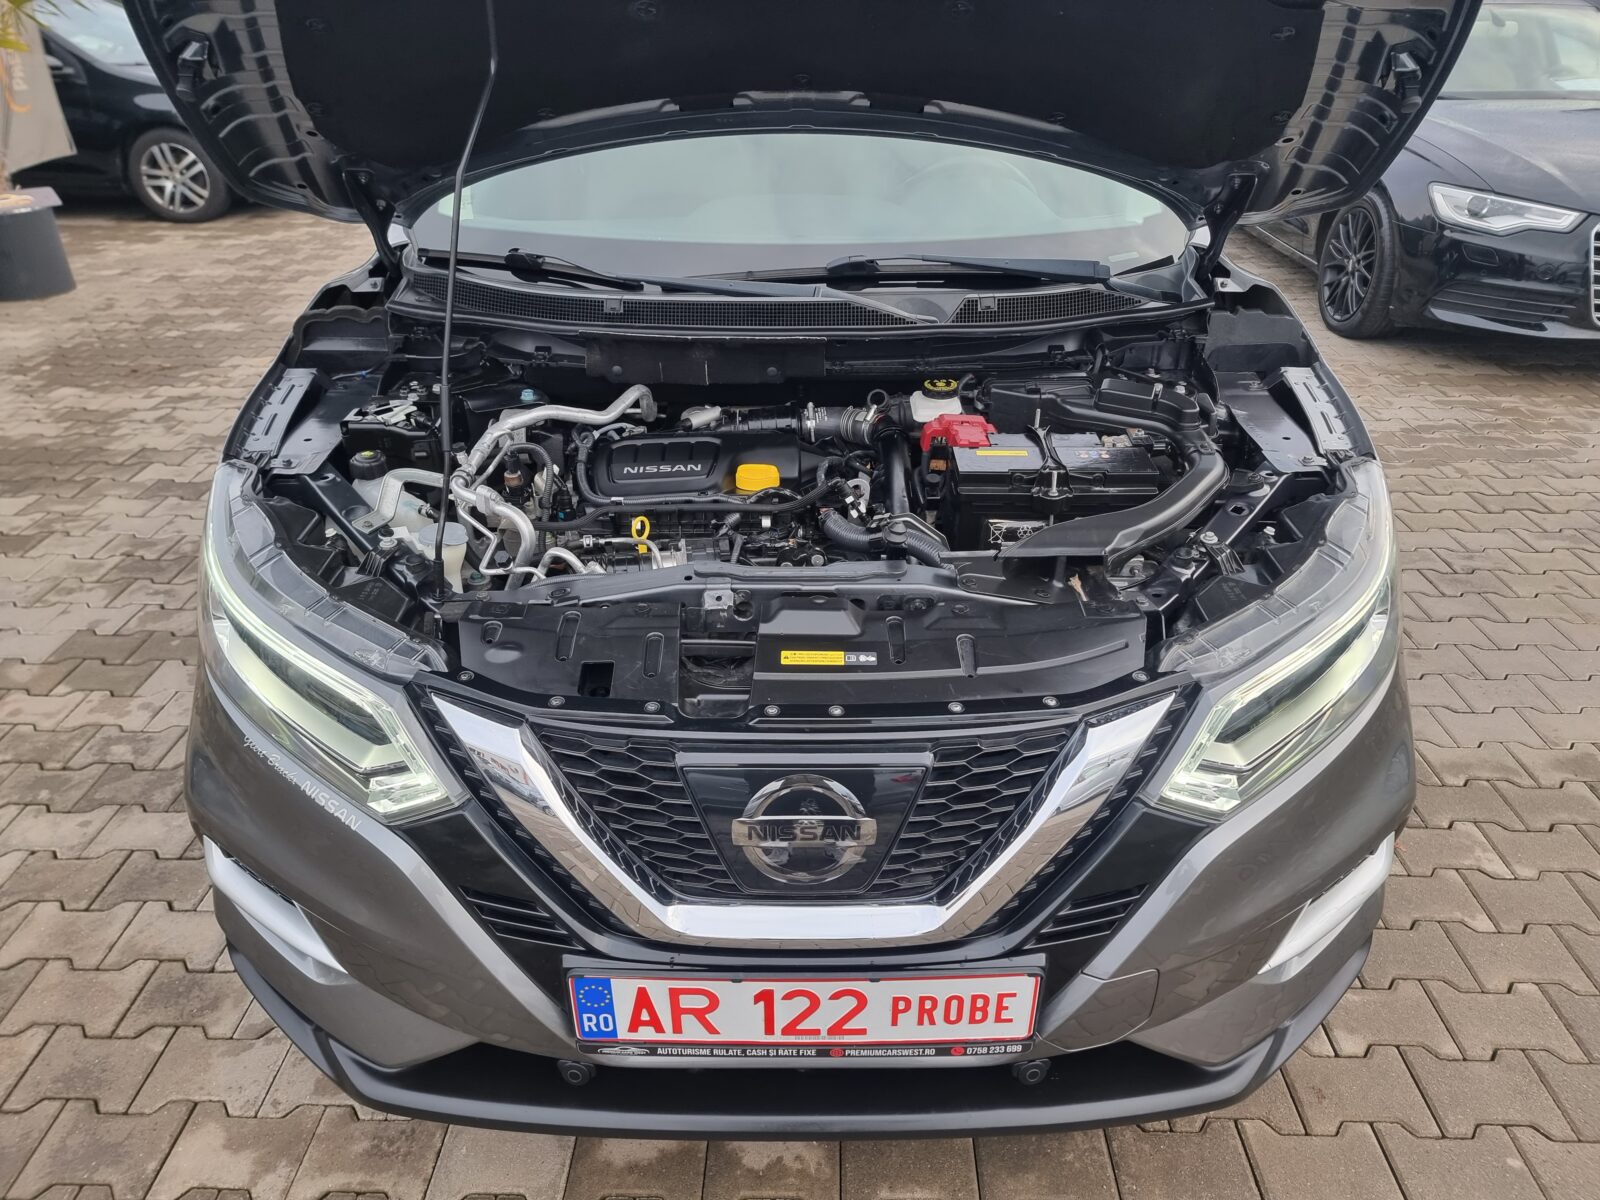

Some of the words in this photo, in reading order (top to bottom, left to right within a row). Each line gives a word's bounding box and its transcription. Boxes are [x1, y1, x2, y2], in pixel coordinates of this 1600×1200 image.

[623, 464, 702, 474] NISSAN
[301, 781, 361, 831] NISSAN
[748, 824, 861, 843] NISSAN
[627, 986, 721, 1034] AR
[753, 988, 868, 1035] 122
[890, 992, 1017, 1027] PROBE
[582, 1013, 614, 1032] RO
[657, 1047, 711, 1056] AUTOTURISME
[713, 1048, 745, 1057] RULATE,
[746, 1049, 767, 1057] CASH
[778, 1049, 798, 1057] RATE
[799, 1049, 817, 1057] FIXE
[845, 1048, 936, 1058] PREMIUMCARSWEST.RO
[966, 1047, 988, 1055] 0758
[989, 1045, 1005, 1054] 233
